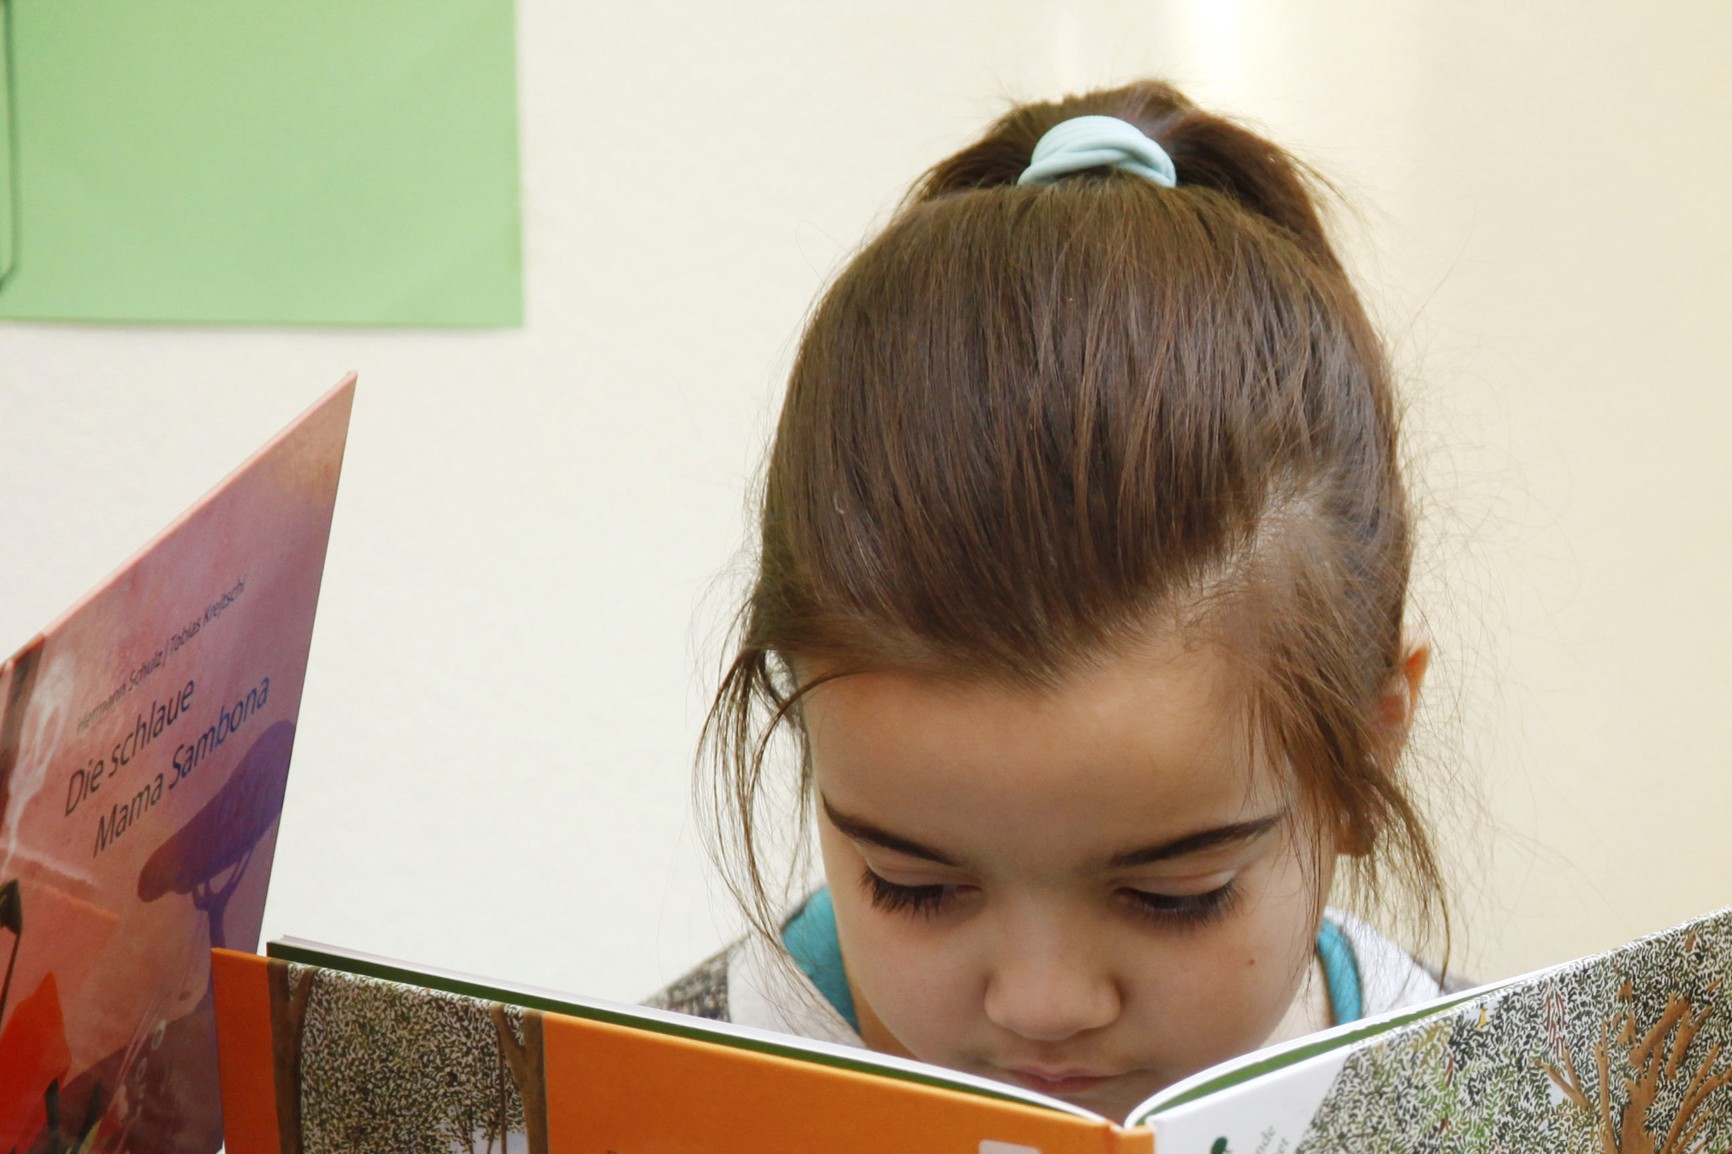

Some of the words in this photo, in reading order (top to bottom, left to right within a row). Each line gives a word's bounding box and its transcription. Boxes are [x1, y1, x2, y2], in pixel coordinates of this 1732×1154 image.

[77, 683, 126, 734] Hermann
[128, 649, 163, 691] Schulz
[169, 616, 201, 655] Tobias
[65, 758, 104, 817] Die
[108, 679, 195, 778] schlaue
[93, 772, 164, 858] Mama
[168, 676, 269, 790] Sambona
